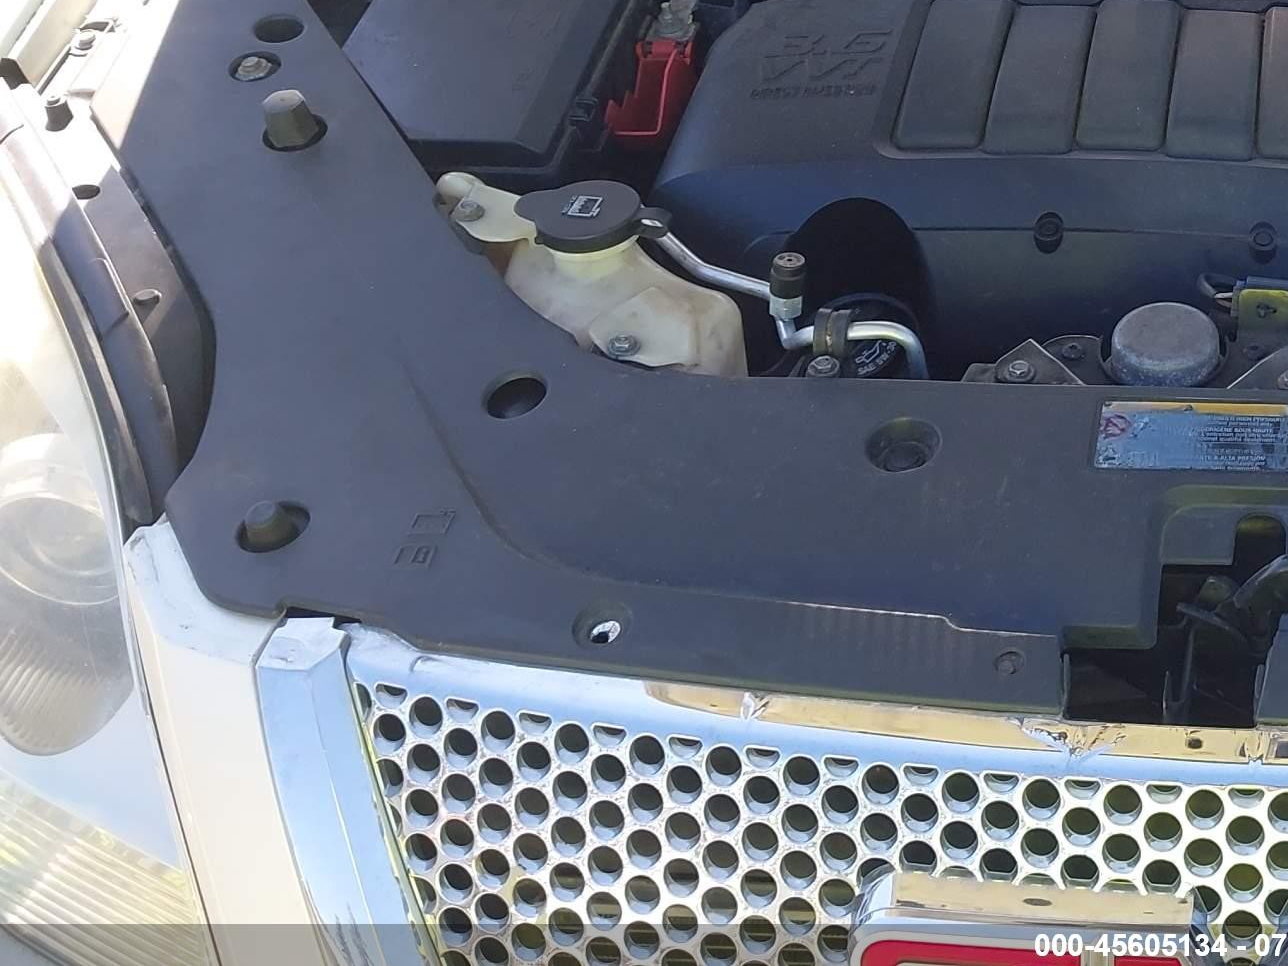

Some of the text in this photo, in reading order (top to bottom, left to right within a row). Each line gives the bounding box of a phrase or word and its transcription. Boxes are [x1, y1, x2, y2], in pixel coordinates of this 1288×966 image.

[763, 30, 894, 59] 3.6
[759, 57, 884, 82] VVT
[857, 362, 877, 376] SAE
